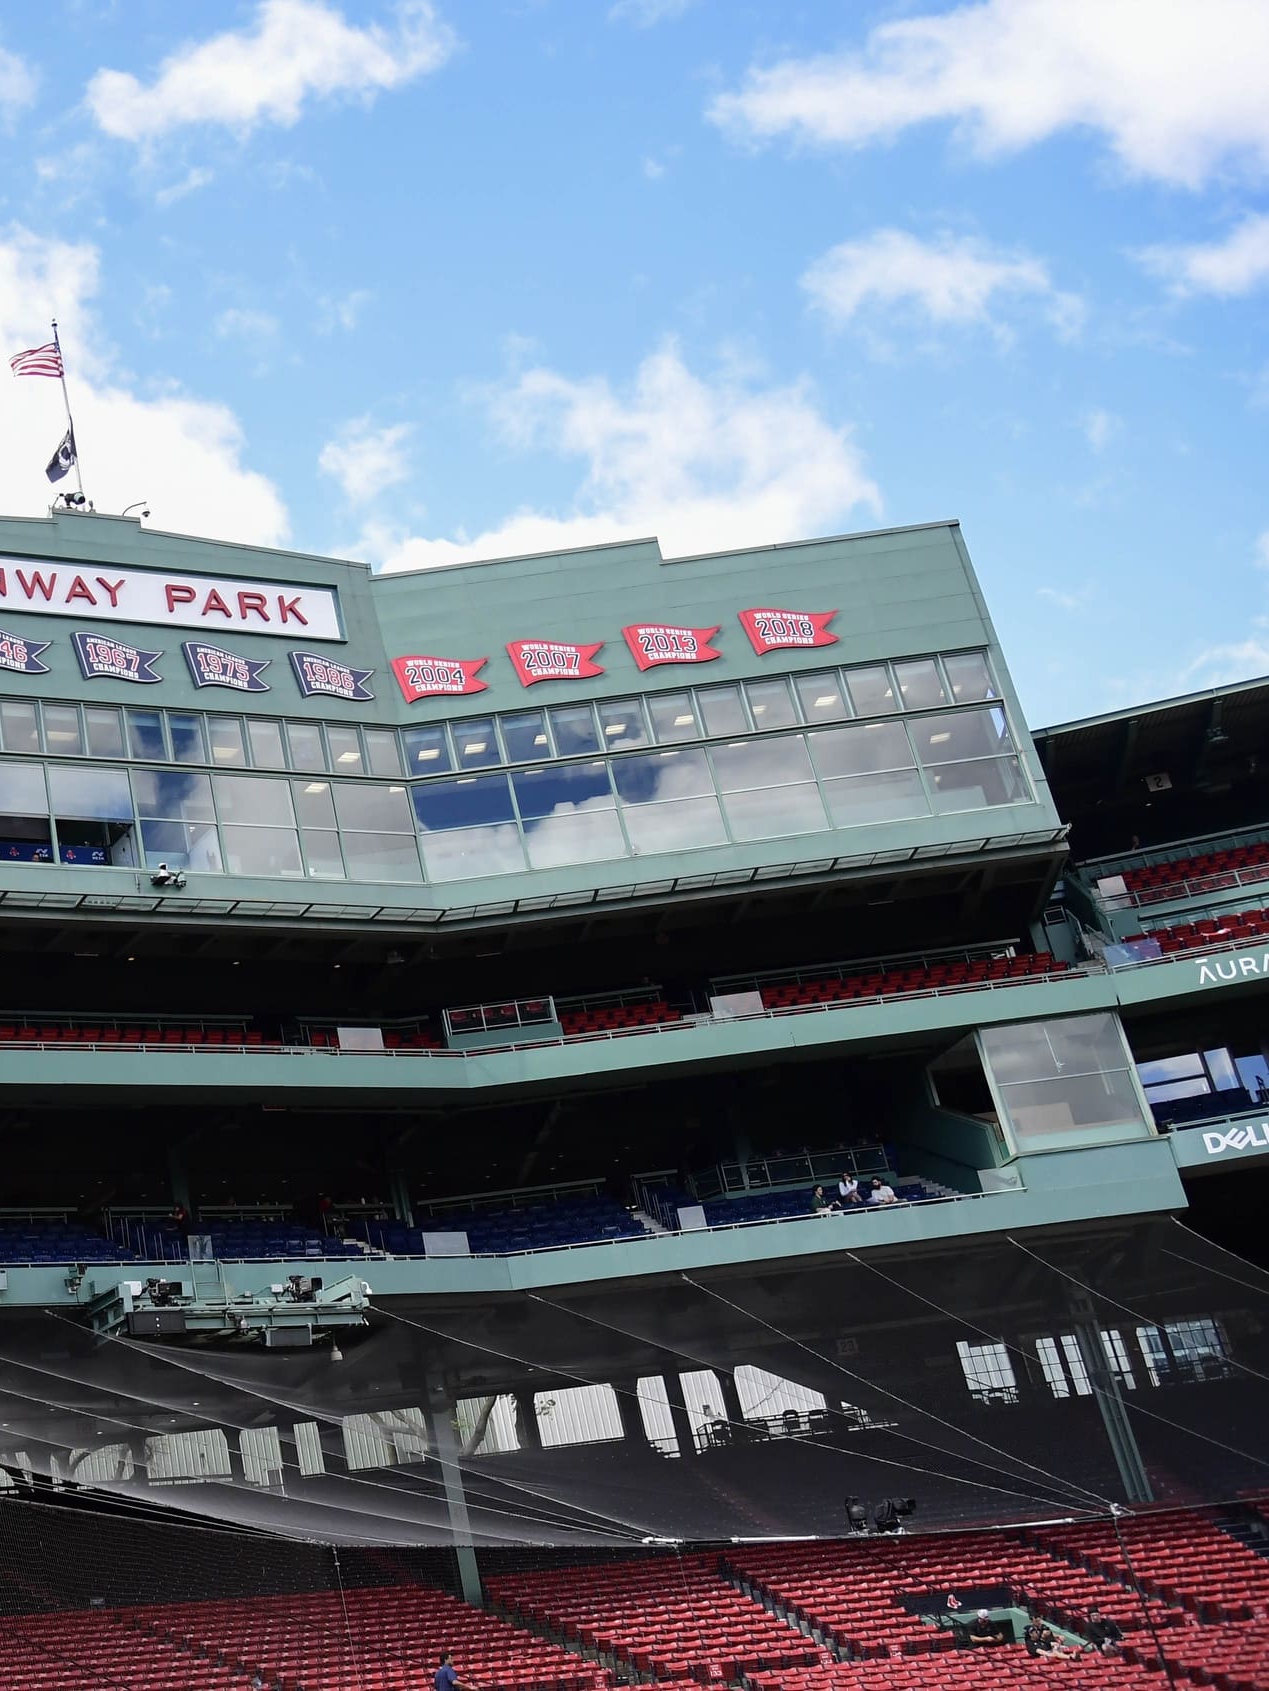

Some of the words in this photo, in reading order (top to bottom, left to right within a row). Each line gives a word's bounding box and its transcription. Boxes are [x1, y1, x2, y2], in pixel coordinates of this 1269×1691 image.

[165, 583, 309, 626] PARK
[753, 612, 781, 620] WORLD
[781, 613, 809, 621] SERIES
[637, 628, 664, 636] WORLD
[665, 629, 692, 637] SERIES
[755, 619, 814, 639] 2018
[87, 637, 114, 649] AMERICAN
[521, 643, 548, 651] WORLD
[549, 644, 576, 652] SERIES
[639, 634, 697, 653] 2013
[764, 636, 814, 645] CHAMPIONS
[87, 643, 139, 671] 1967
[197, 647, 222, 657] AMERICAN
[648, 652, 697, 660] CHAMPIONS
[197, 652, 249, 681] 1975
[303, 656, 329, 667] AMERICAN
[433, 660, 460, 669] SERIES
[521, 650, 580, 670] 2007
[93, 663, 139, 679] CHAMPIONS
[303, 663, 355, 690] 1986
[405, 666, 465, 687] 2004
[531, 667, 579, 676] CHAMPIONS
[204, 672, 248, 688] CHAMPIONS
[310, 681, 353, 697] CHAMPIONS
[415, 684, 463, 692] CHAMPIONS
